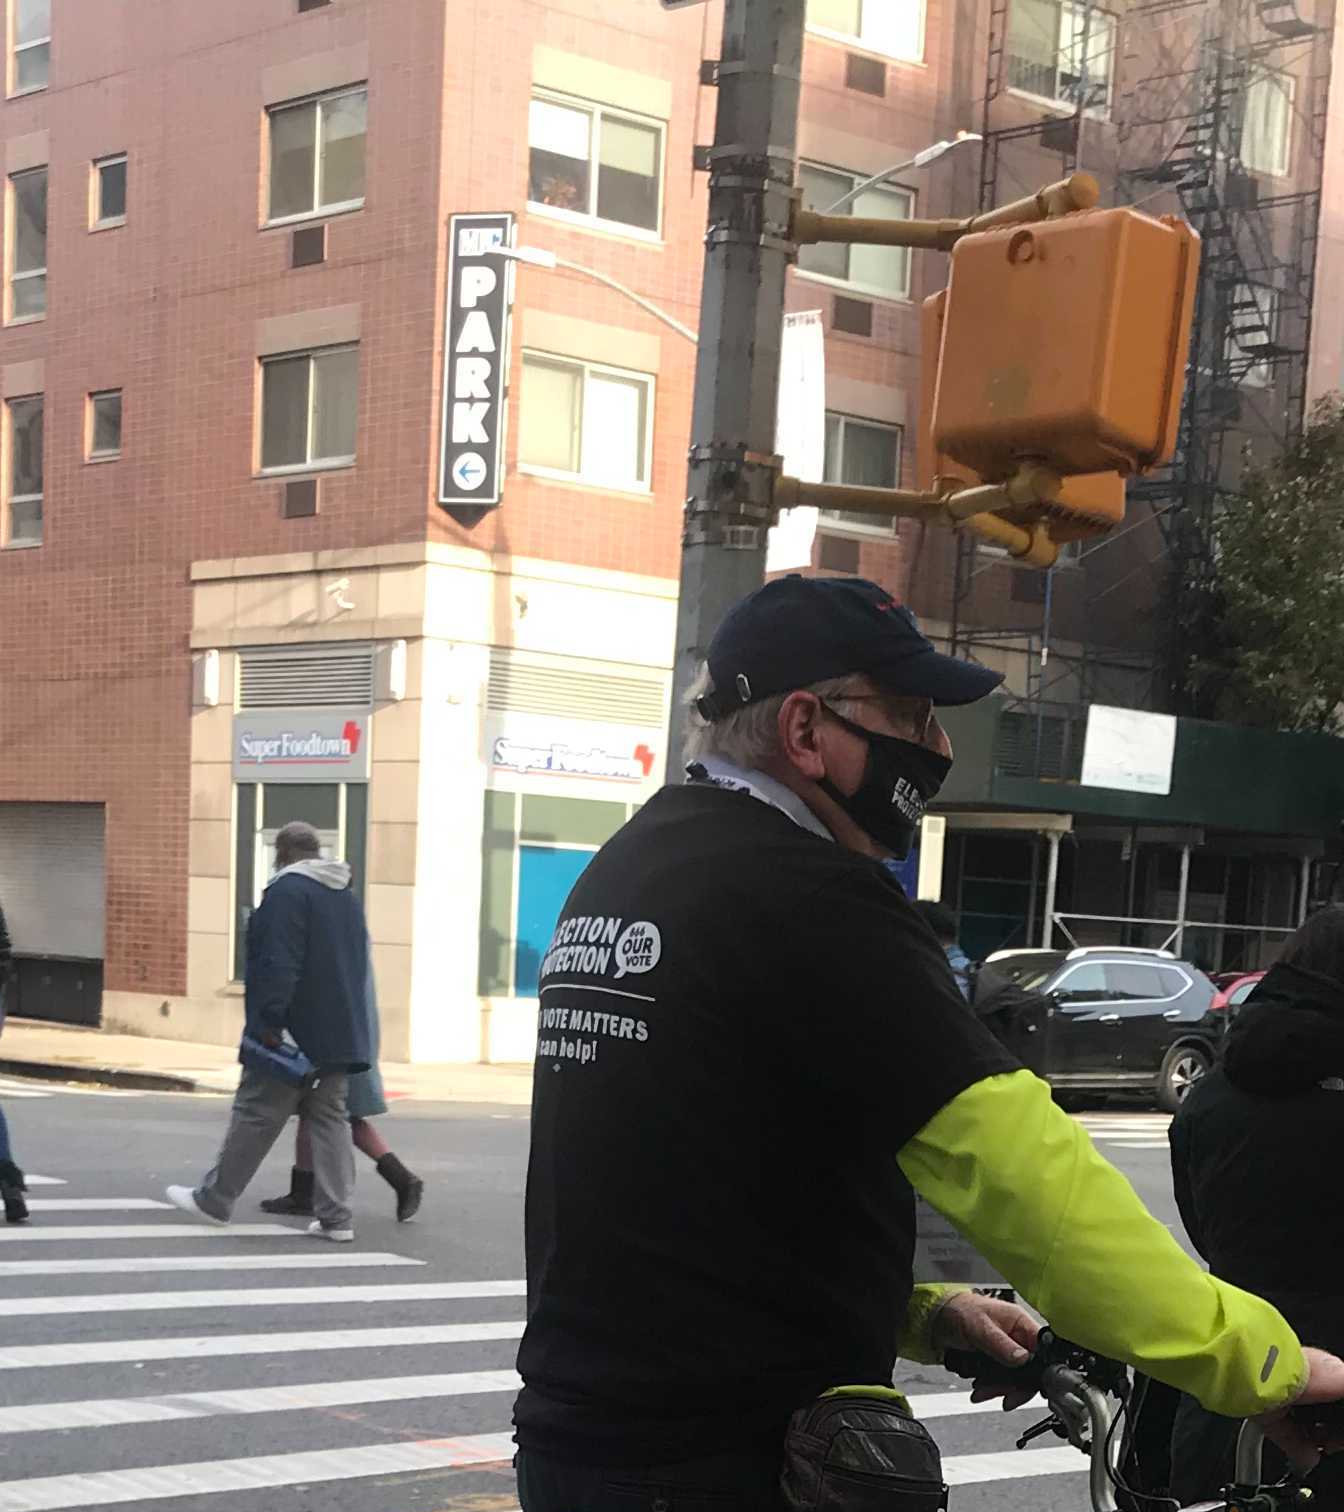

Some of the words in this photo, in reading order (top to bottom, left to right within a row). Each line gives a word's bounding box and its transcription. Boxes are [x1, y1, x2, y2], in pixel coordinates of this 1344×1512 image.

[452, 265, 497, 444] PARK
[622, 937, 654, 955] OUR
[625, 955, 652, 967] VOTE
[542, 1008, 569, 1029] VOTE
[568, 1009, 649, 1041] MATTERS
[558, 1036, 598, 1065] help!
